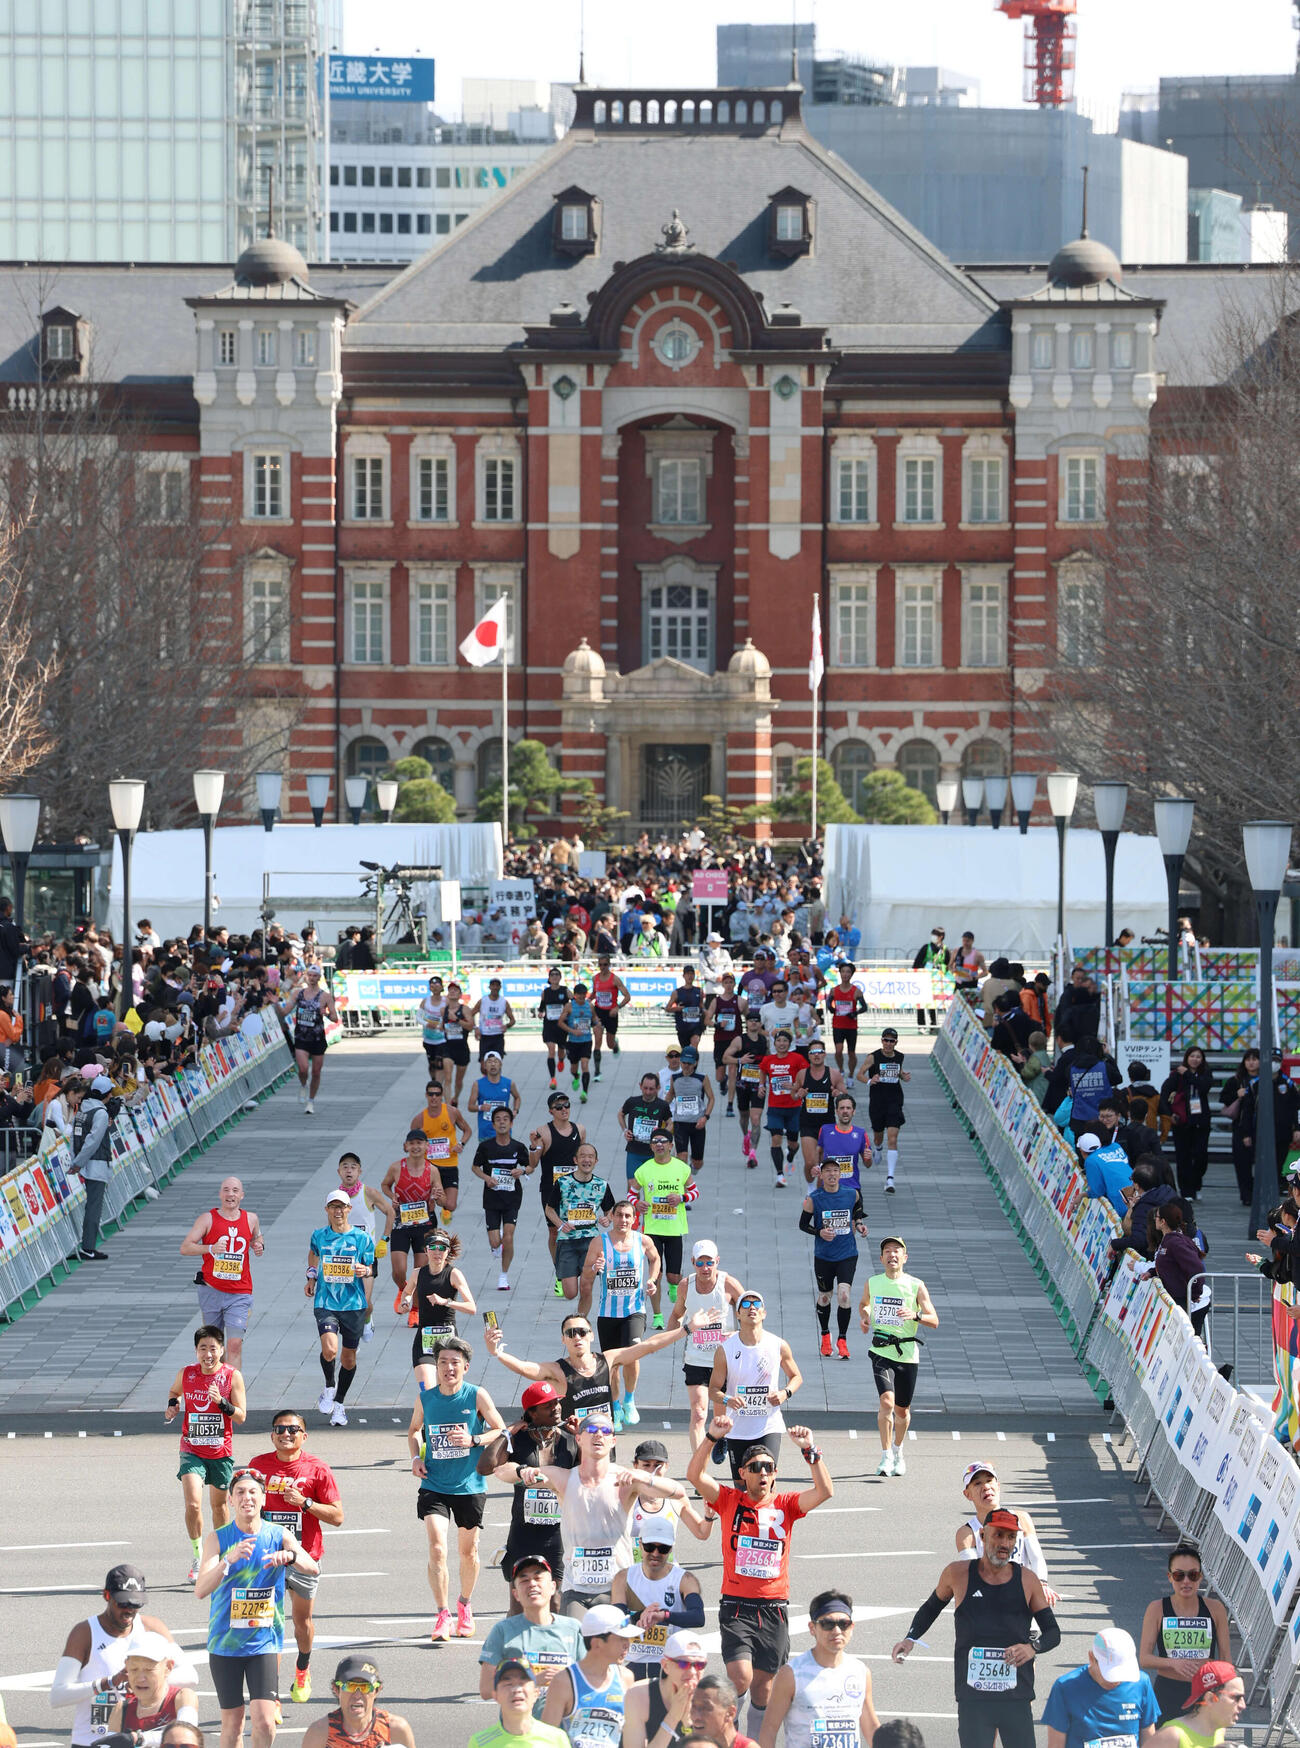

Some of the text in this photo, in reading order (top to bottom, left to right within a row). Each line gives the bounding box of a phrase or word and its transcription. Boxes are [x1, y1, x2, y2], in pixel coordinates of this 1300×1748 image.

[329, 61, 412, 85] 近畿大学
[357, 88, 412, 96] UNIVERSITY
[329, 1264, 350, 1274] 30986
[614, 1277, 635, 1287] 10692
[196, 1424, 220, 1436] 10537
[533, 1501, 559, 1514] 10617
[745, 1550, 775, 1567] 25668
[582, 1559, 609, 1572] 11054
[1174, 1631, 1205, 1645] 23874
[979, 1663, 1010, 1677] 25648
[581, 1721, 615, 1738] 22157
[813, 1734, 854, 1748] B 23618
